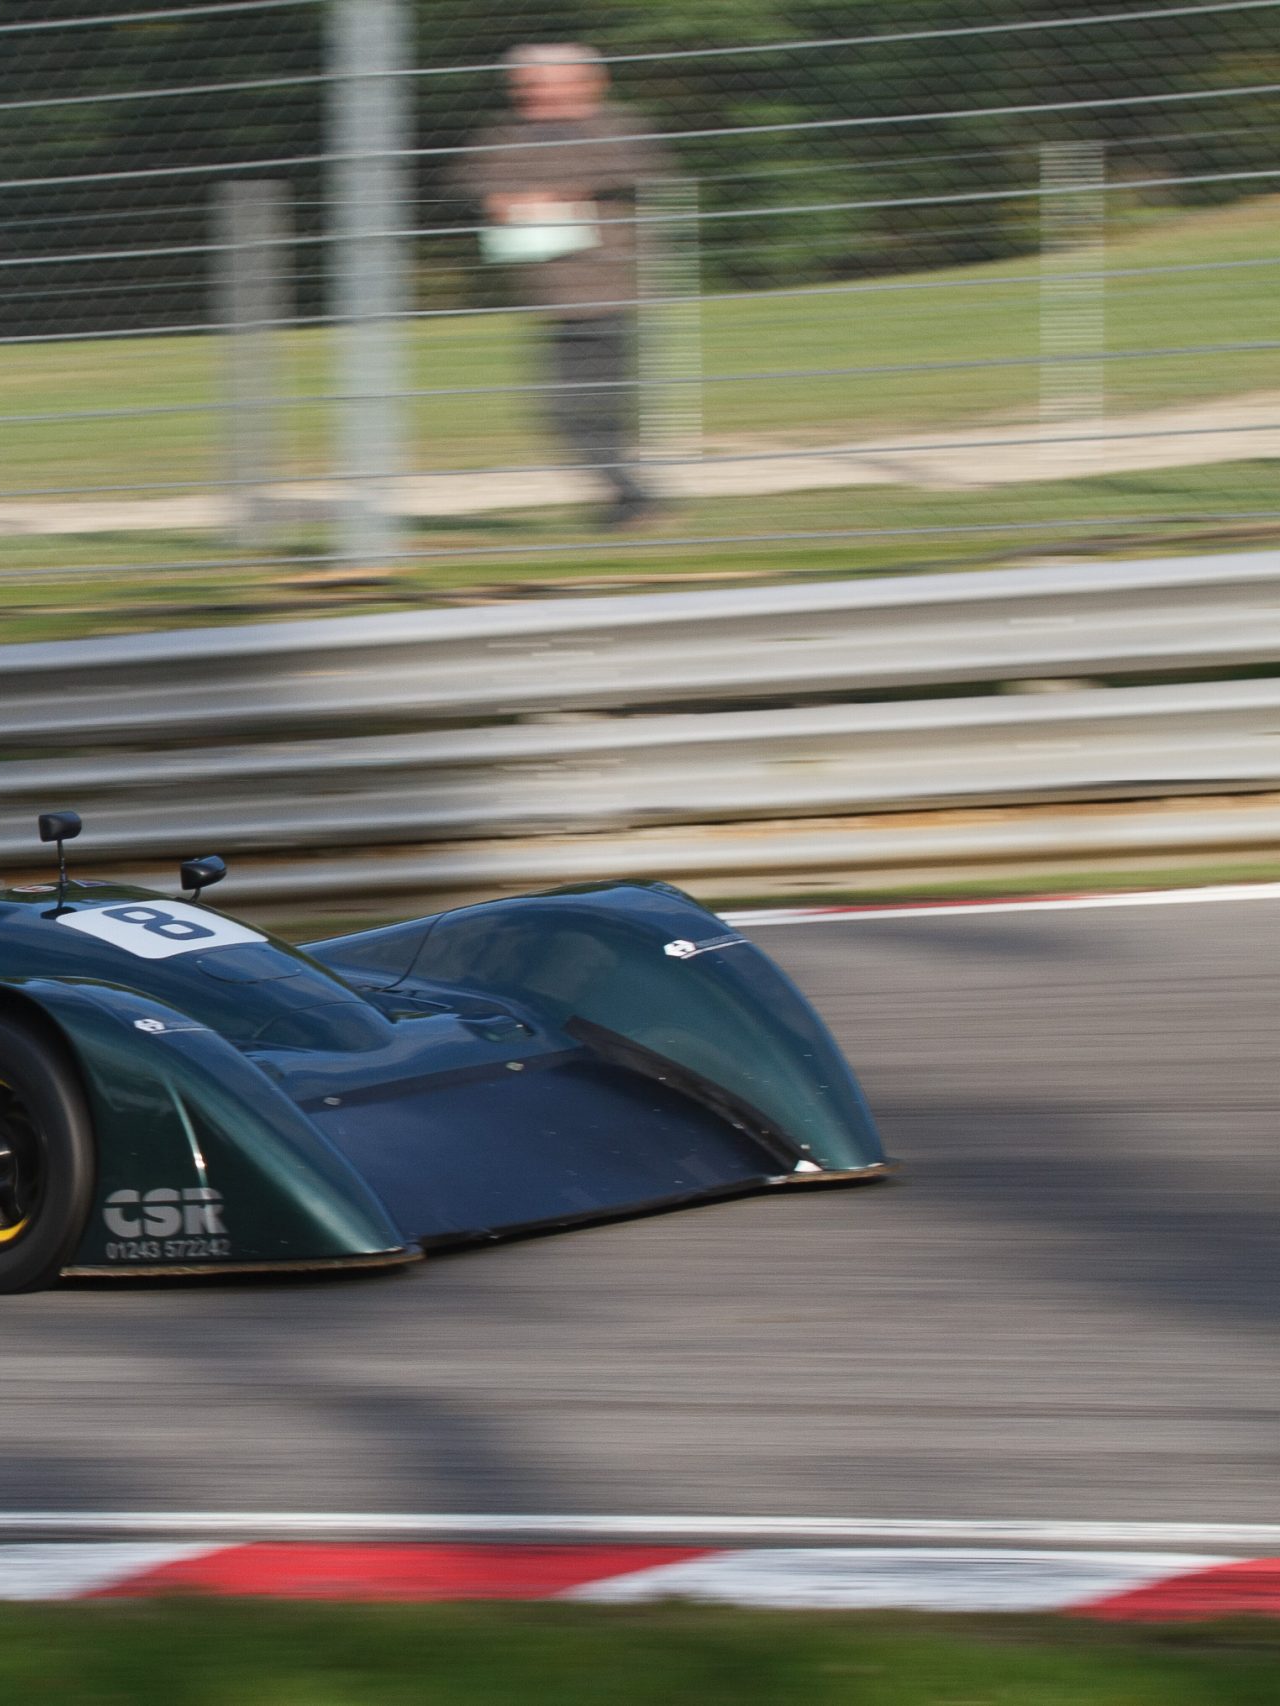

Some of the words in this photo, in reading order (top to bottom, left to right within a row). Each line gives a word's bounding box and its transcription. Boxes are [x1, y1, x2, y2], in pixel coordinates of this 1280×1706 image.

[102, 906, 216, 941] 8
[102, 1187, 229, 1238] CSR
[106, 1241, 161, 1260] 01243
